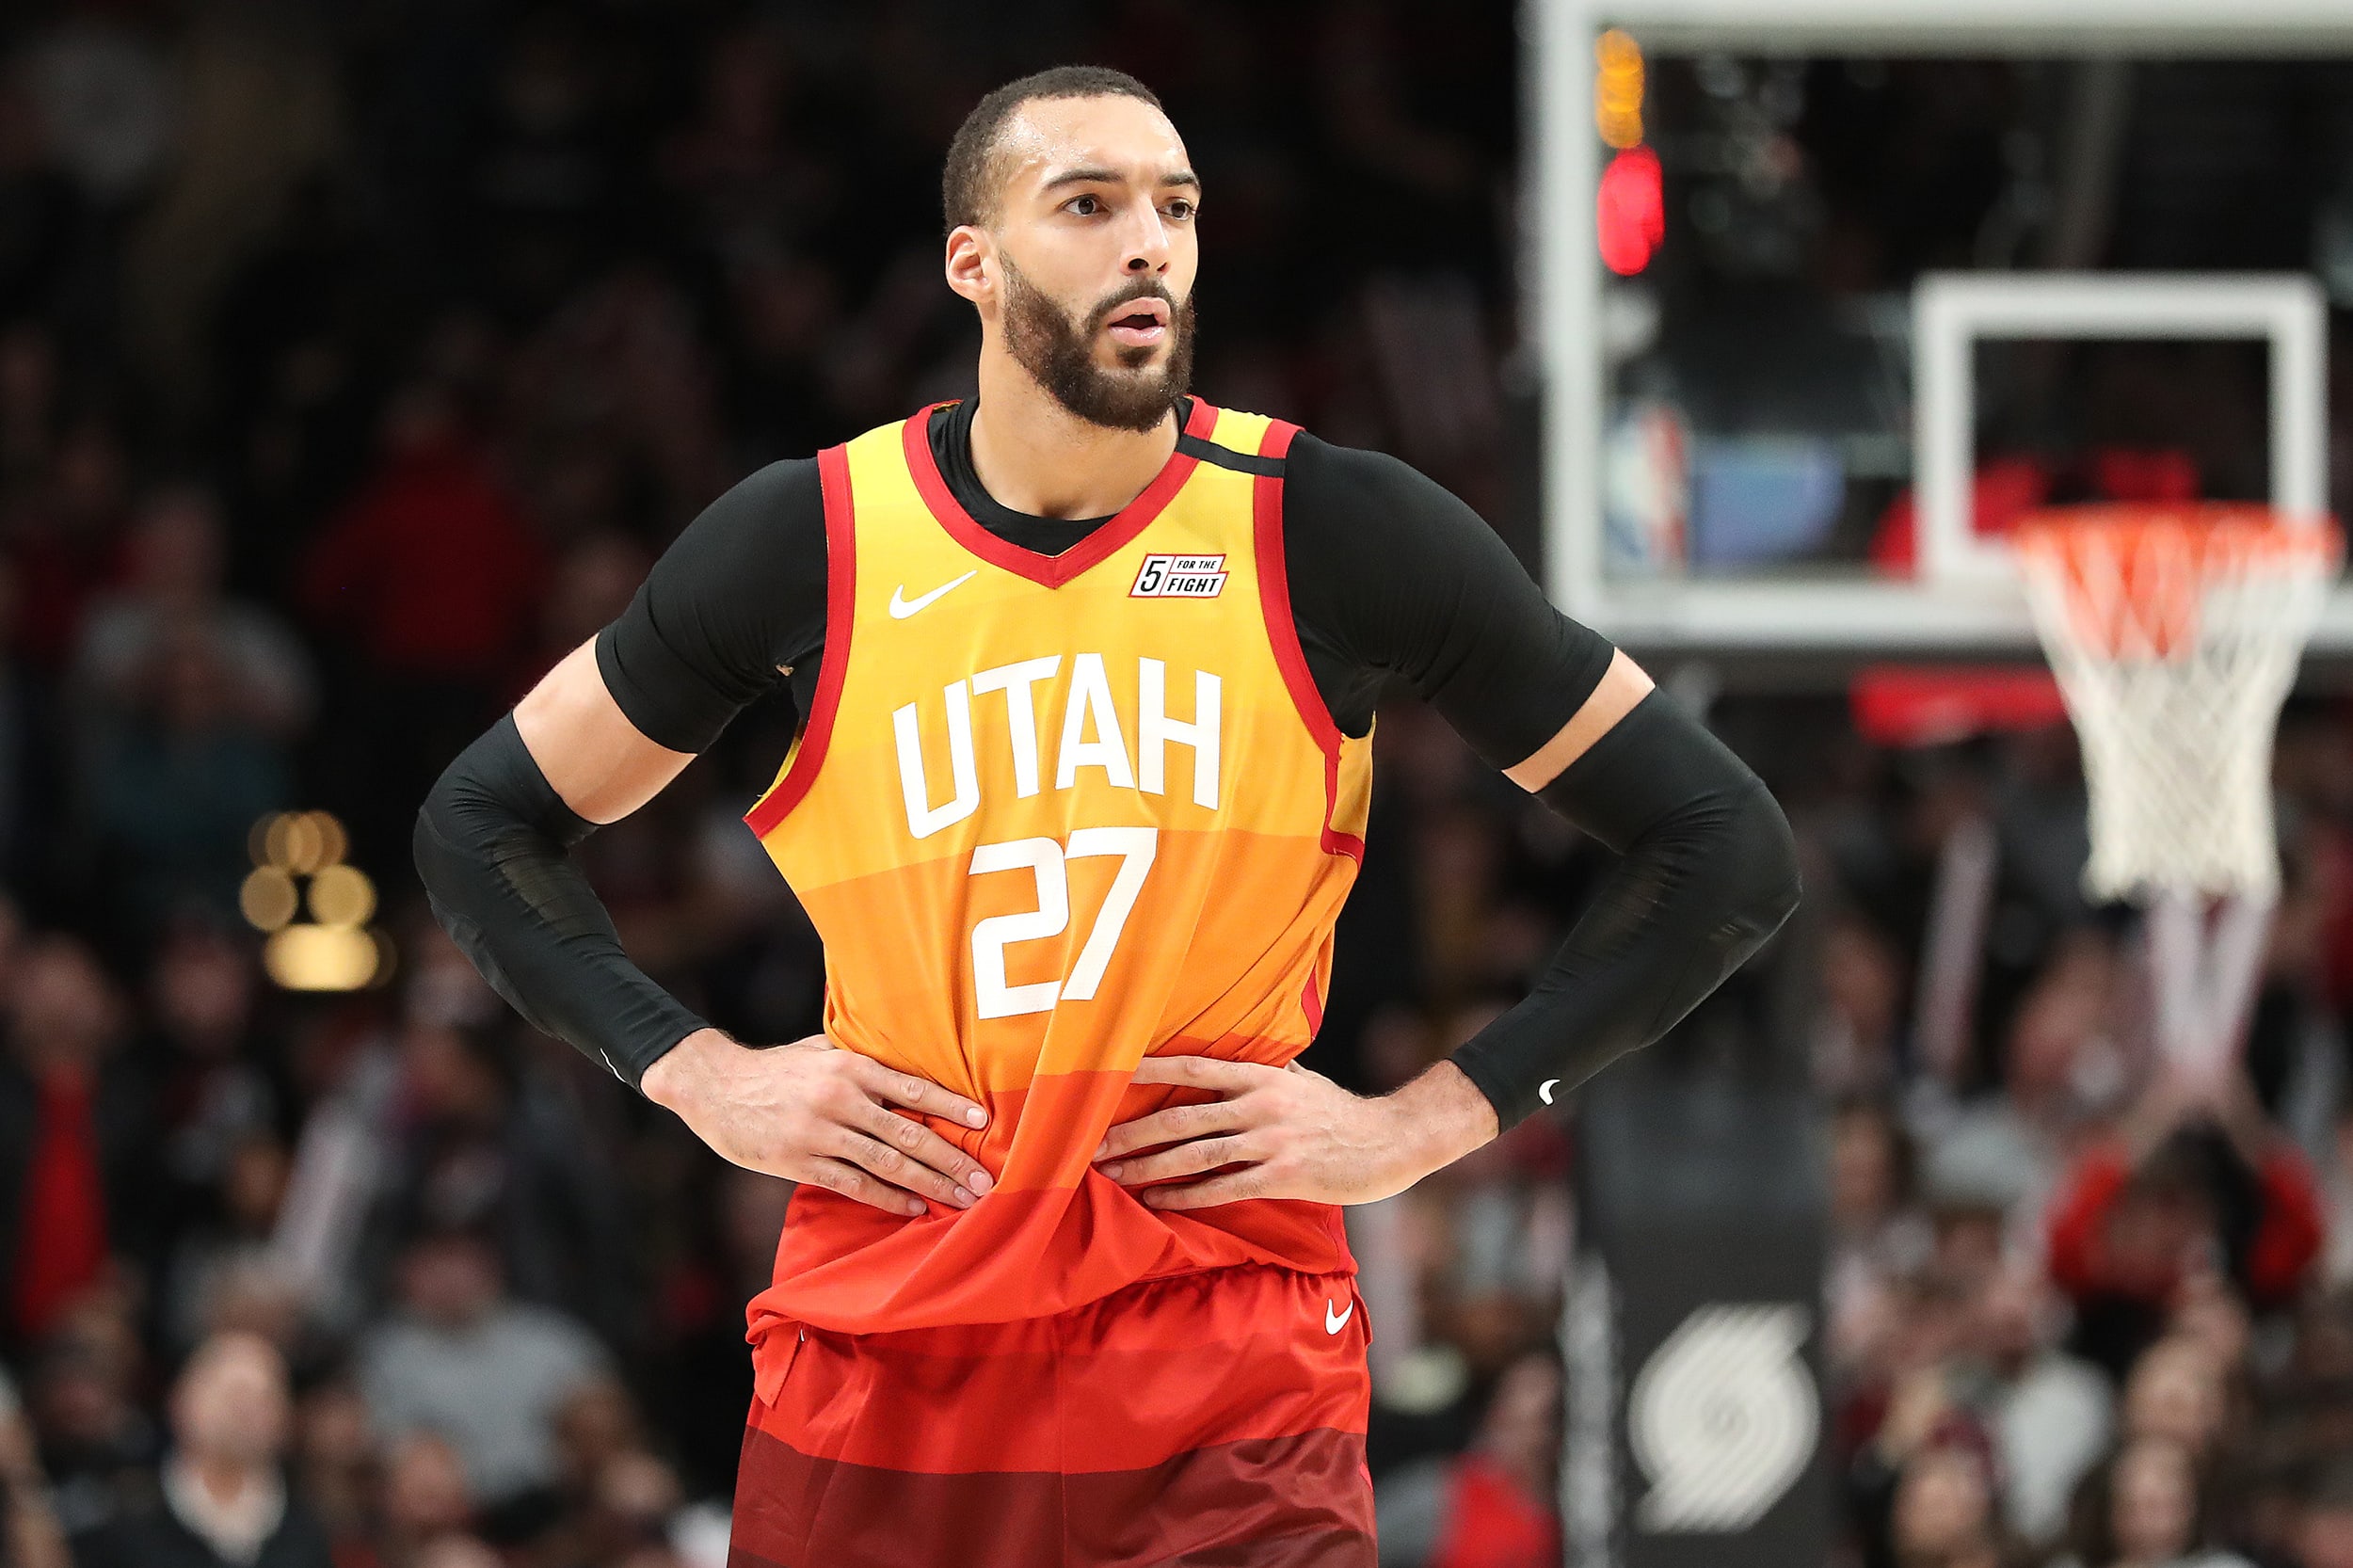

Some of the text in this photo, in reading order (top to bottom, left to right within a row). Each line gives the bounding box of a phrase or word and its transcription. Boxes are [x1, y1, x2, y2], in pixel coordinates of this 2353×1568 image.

[1140, 560, 1167, 592] 5
[1176, 560, 1217, 569] FOR THE
[1166, 578, 1220, 592] FIGHT
[891, 652, 1222, 840] UTAH
[968, 827, 1159, 1020] 27
